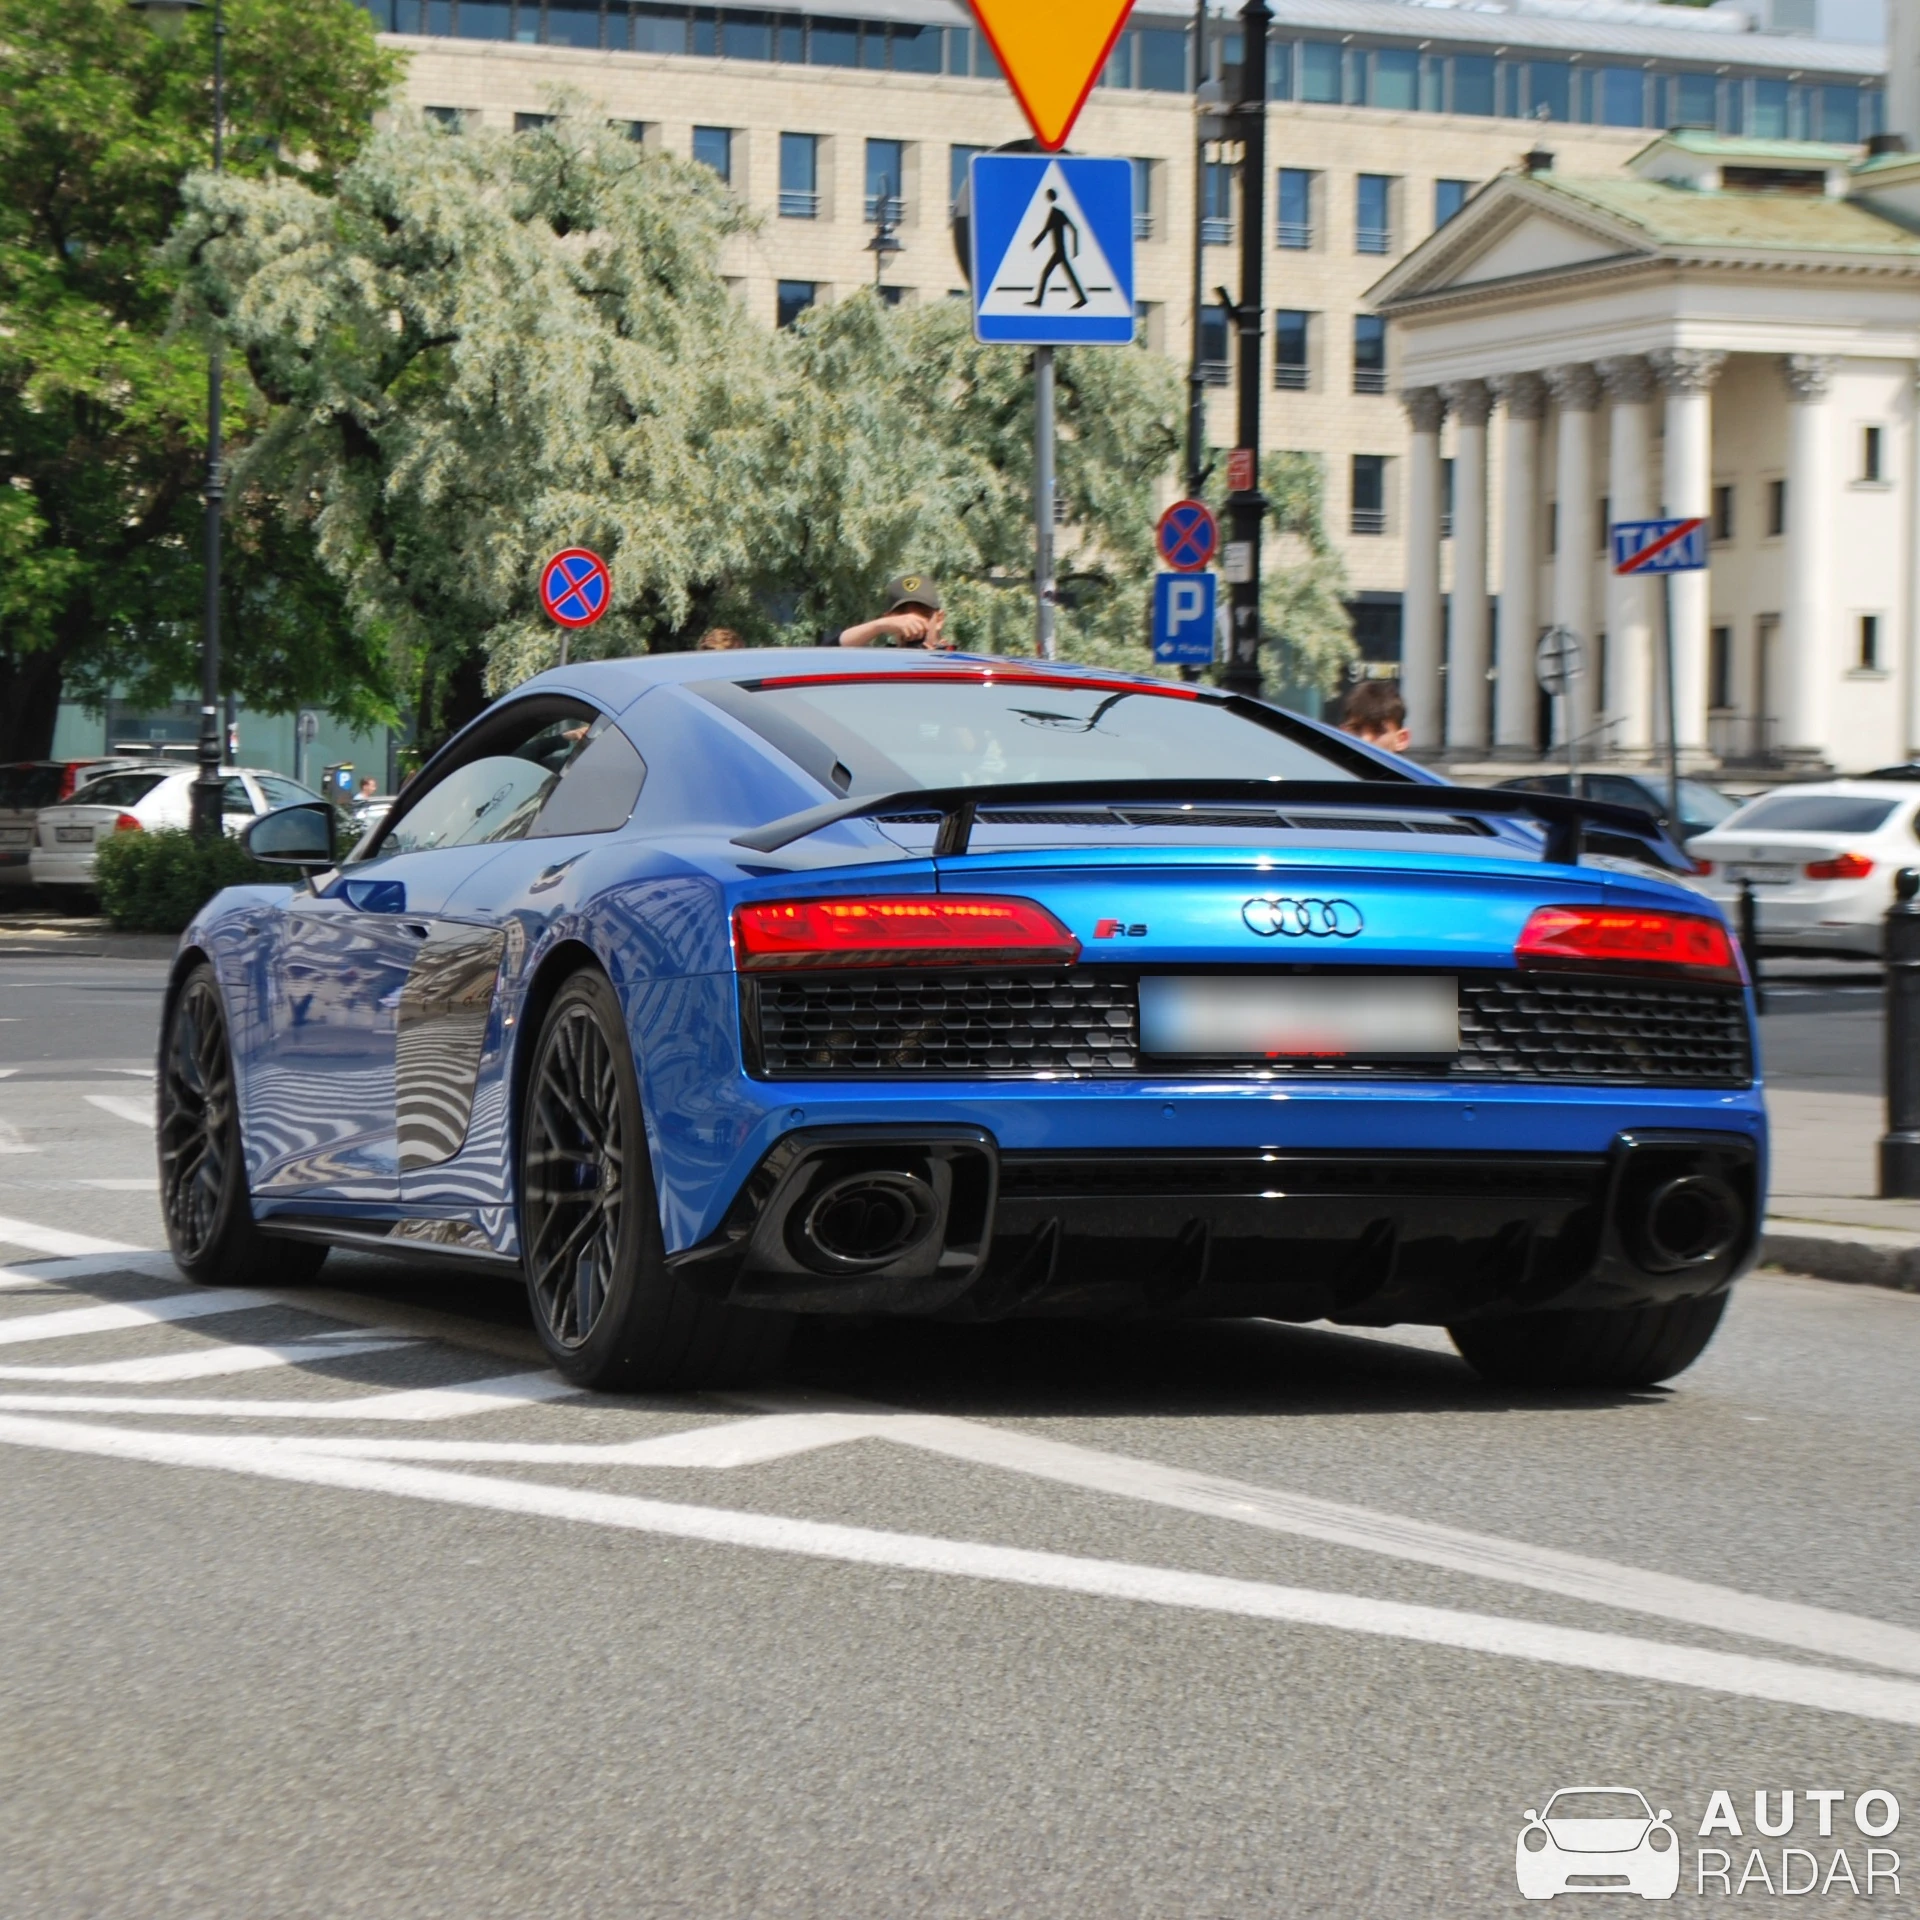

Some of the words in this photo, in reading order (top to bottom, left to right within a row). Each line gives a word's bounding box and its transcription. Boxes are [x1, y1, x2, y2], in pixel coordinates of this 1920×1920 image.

[1614, 525, 1704, 567] TAXI
[1167, 581, 1204, 636] P
[339, 771, 350, 787] P
[1104, 922, 1148, 937] R8
